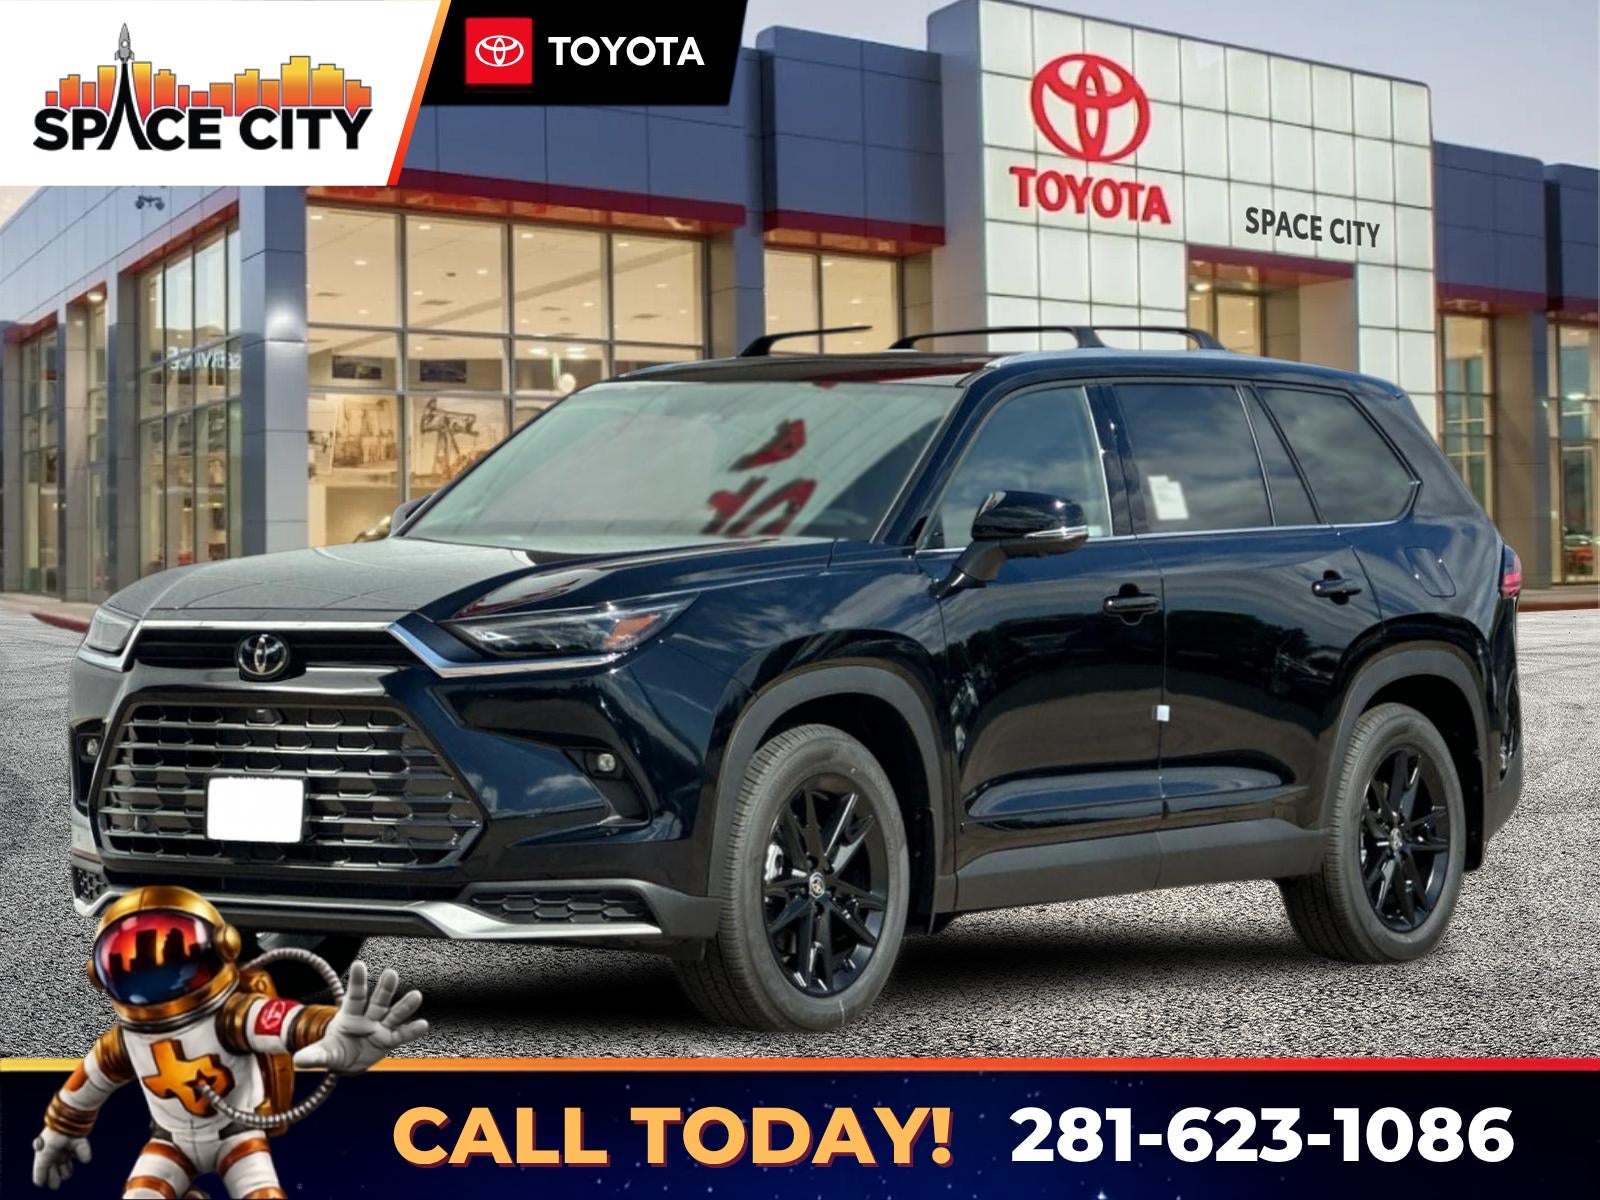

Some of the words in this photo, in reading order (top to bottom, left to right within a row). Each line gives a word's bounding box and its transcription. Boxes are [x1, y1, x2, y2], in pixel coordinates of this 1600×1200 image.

[1009, 166, 1171, 224] TOYOTA
[1245, 206, 1323, 242] SPACE
[1329, 218, 1381, 248] CITY
